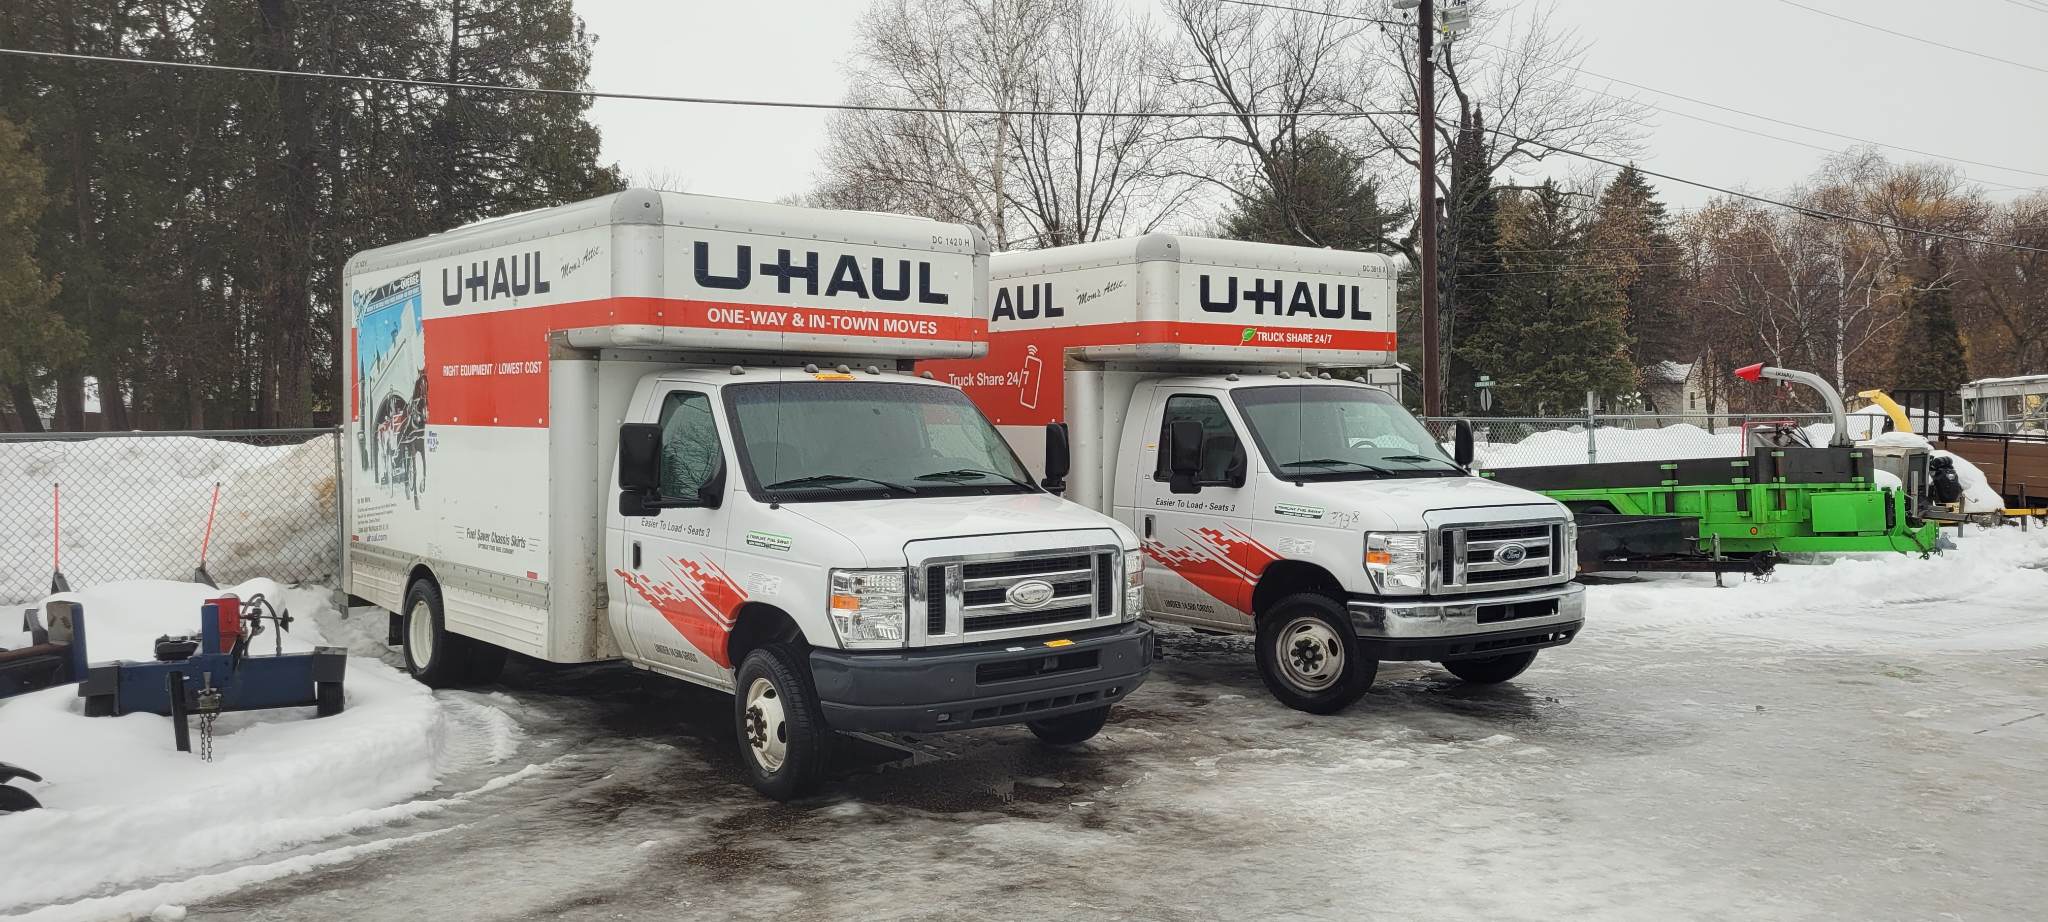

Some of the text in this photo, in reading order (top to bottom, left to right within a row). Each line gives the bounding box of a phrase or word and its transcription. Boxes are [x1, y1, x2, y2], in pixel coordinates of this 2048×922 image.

[932, 235, 970, 247] DC 1420 H
[442, 251, 550, 306] U-HAUL
[693, 241, 949, 305] U-HAUL
[1103, 280, 1123, 296] Attic
[1199, 274, 1372, 321] U-HAUL
[707, 307, 938, 335] ONE-WAY & IN-TOWN MOVES
[1257, 331, 1333, 344] TRUCK SHARE 24/7
[443, 365, 460, 377] RIGHT
[460, 364, 493, 376] EQUIPMENT
[498, 362, 523, 374] LOWEST
[525, 361, 542, 374] COST
[948, 368, 1029, 388] Truck Share 24/7
[1155, 497, 1175, 507] Easier
[1177, 499, 1185, 508] To
[1187, 500, 1203, 510] Load
[1209, 502, 1229, 512] Seats
[641, 517, 711, 537] Easier To Load Seats 3
[466, 527, 476, 539] Fuel
[477, 529, 490, 542] Saver
[490, 531, 510, 546] Chassis
[511, 535, 526, 549] Skirts
[1163, 600, 1181, 609] UNDER
